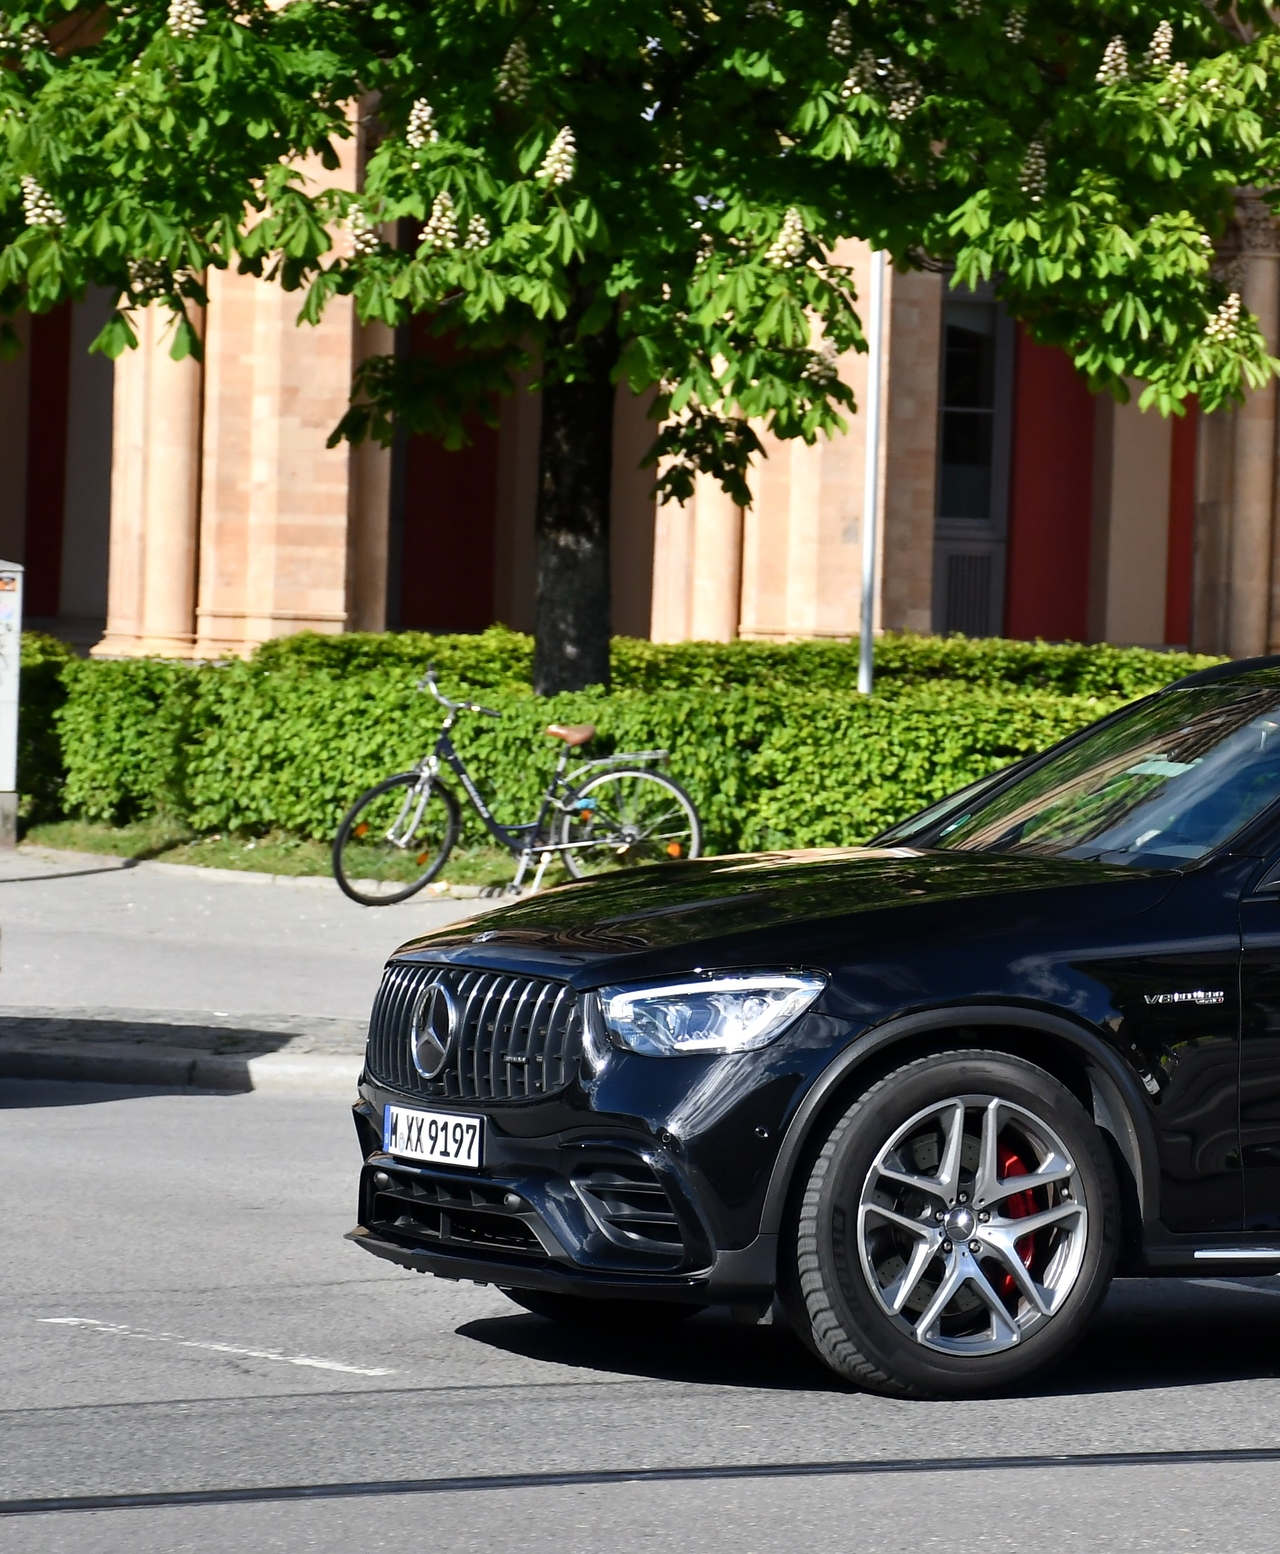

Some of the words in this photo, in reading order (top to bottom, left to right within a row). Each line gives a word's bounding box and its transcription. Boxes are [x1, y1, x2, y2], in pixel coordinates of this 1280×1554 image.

[1144, 994, 1173, 1004] V8
[390, 1112, 399, 1149] M
[405, 1115, 425, 1153] XX
[428, 1119, 477, 1160] 9197
